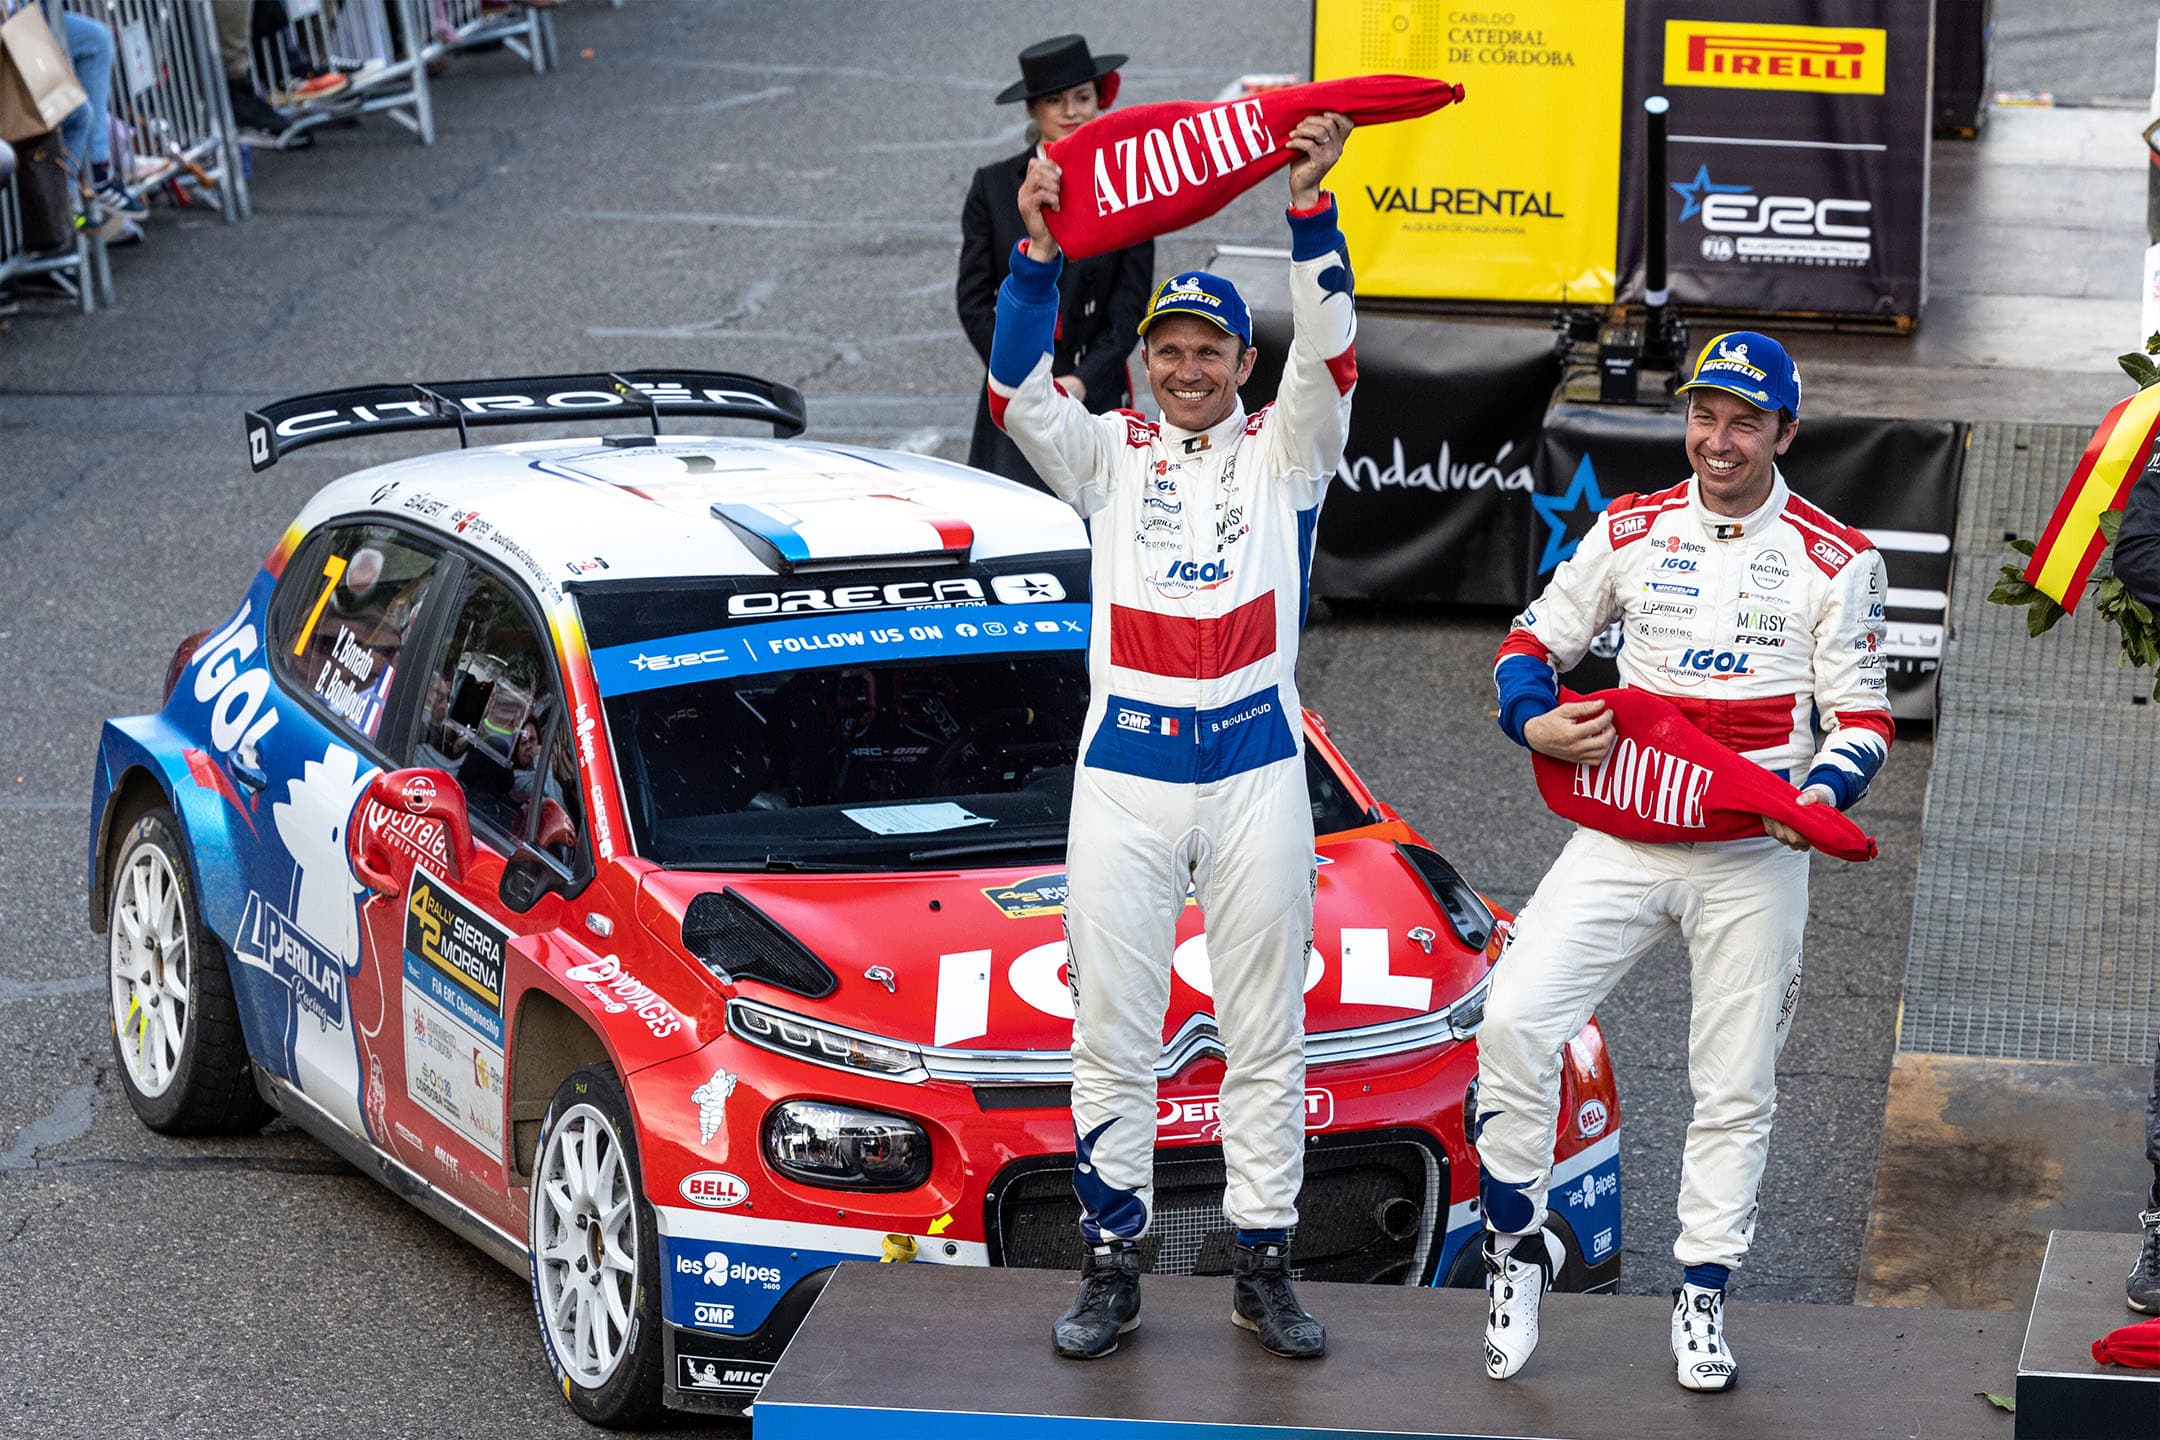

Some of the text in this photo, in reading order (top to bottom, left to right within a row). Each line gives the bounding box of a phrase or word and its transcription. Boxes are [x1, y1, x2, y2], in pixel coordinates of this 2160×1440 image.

[1448, 11, 1515, 25] CABILDO
[1448, 28, 1547, 46] CATEDRAL
[1448, 44, 1575, 67] DE CÓRDOBA
[1688, 35, 1865, 80] PIRELLI
[1093, 98, 1276, 218] AZOCHE
[1366, 185, 1565, 218] VALRENTAL
[1702, 193, 1872, 238] ERC
[1155, 294, 1222, 310] MICHELIN
[1700, 361, 1765, 382] MICHELIN
[1613, 518, 1648, 536] OMP
[1651, 538, 1666, 549] les
[1681, 541, 1706, 554] alpes
[1813, 541, 1846, 566] OMP
[1167, 558, 1230, 583] IGOL
[1661, 558, 1698, 572] IGOL
[1750, 563, 1790, 578] RACING
[727, 577, 985, 617] ORECA
[1655, 584, 1697, 595] MICHELIN
[293, 554, 348, 657] 7
[1652, 625, 1693, 638] corelec
[1737, 611, 1787, 633] MARSY
[767, 625, 865, 654] FOLLOW
[872, 627, 905, 644] US
[908, 625, 944, 641] ON
[1735, 634, 1780, 648] FFSA
[1854, 639, 1867, 650] les
[339, 631, 375, 683] Bonato
[1679, 648, 1750, 675] IGOL
[192, 598, 280, 769] IGOL
[1656, 665, 1711, 680] Compétition
[324, 668, 372, 725] Boulloud
[1117, 712, 1151, 730] OMP
[1211, 703, 1272, 733] B. BOULLOUD
[401, 788, 437, 797] RACING
[1572, 735, 1715, 829] AZOCHE
[427, 893, 455, 926] RALLY
[453, 915, 501, 968] SIERRA
[440, 936, 498, 993] MORENA
[291, 974, 328, 1033] Racing
[431, 976, 443, 998] FIA
[456, 995, 500, 1041] Championship
[607, 971, 682, 1038] VOYAGES
[1581, 1106, 1605, 1129] BELL
[689, 1179, 739, 1198] BELL
[1595, 1171, 1617, 1196] alpes
[694, 1195, 732, 1203] HELMETS
[1593, 1231, 1613, 1253] OMP
[676, 1251, 782, 1287] les 2 alpes
[694, 1306, 735, 1326] OMP
